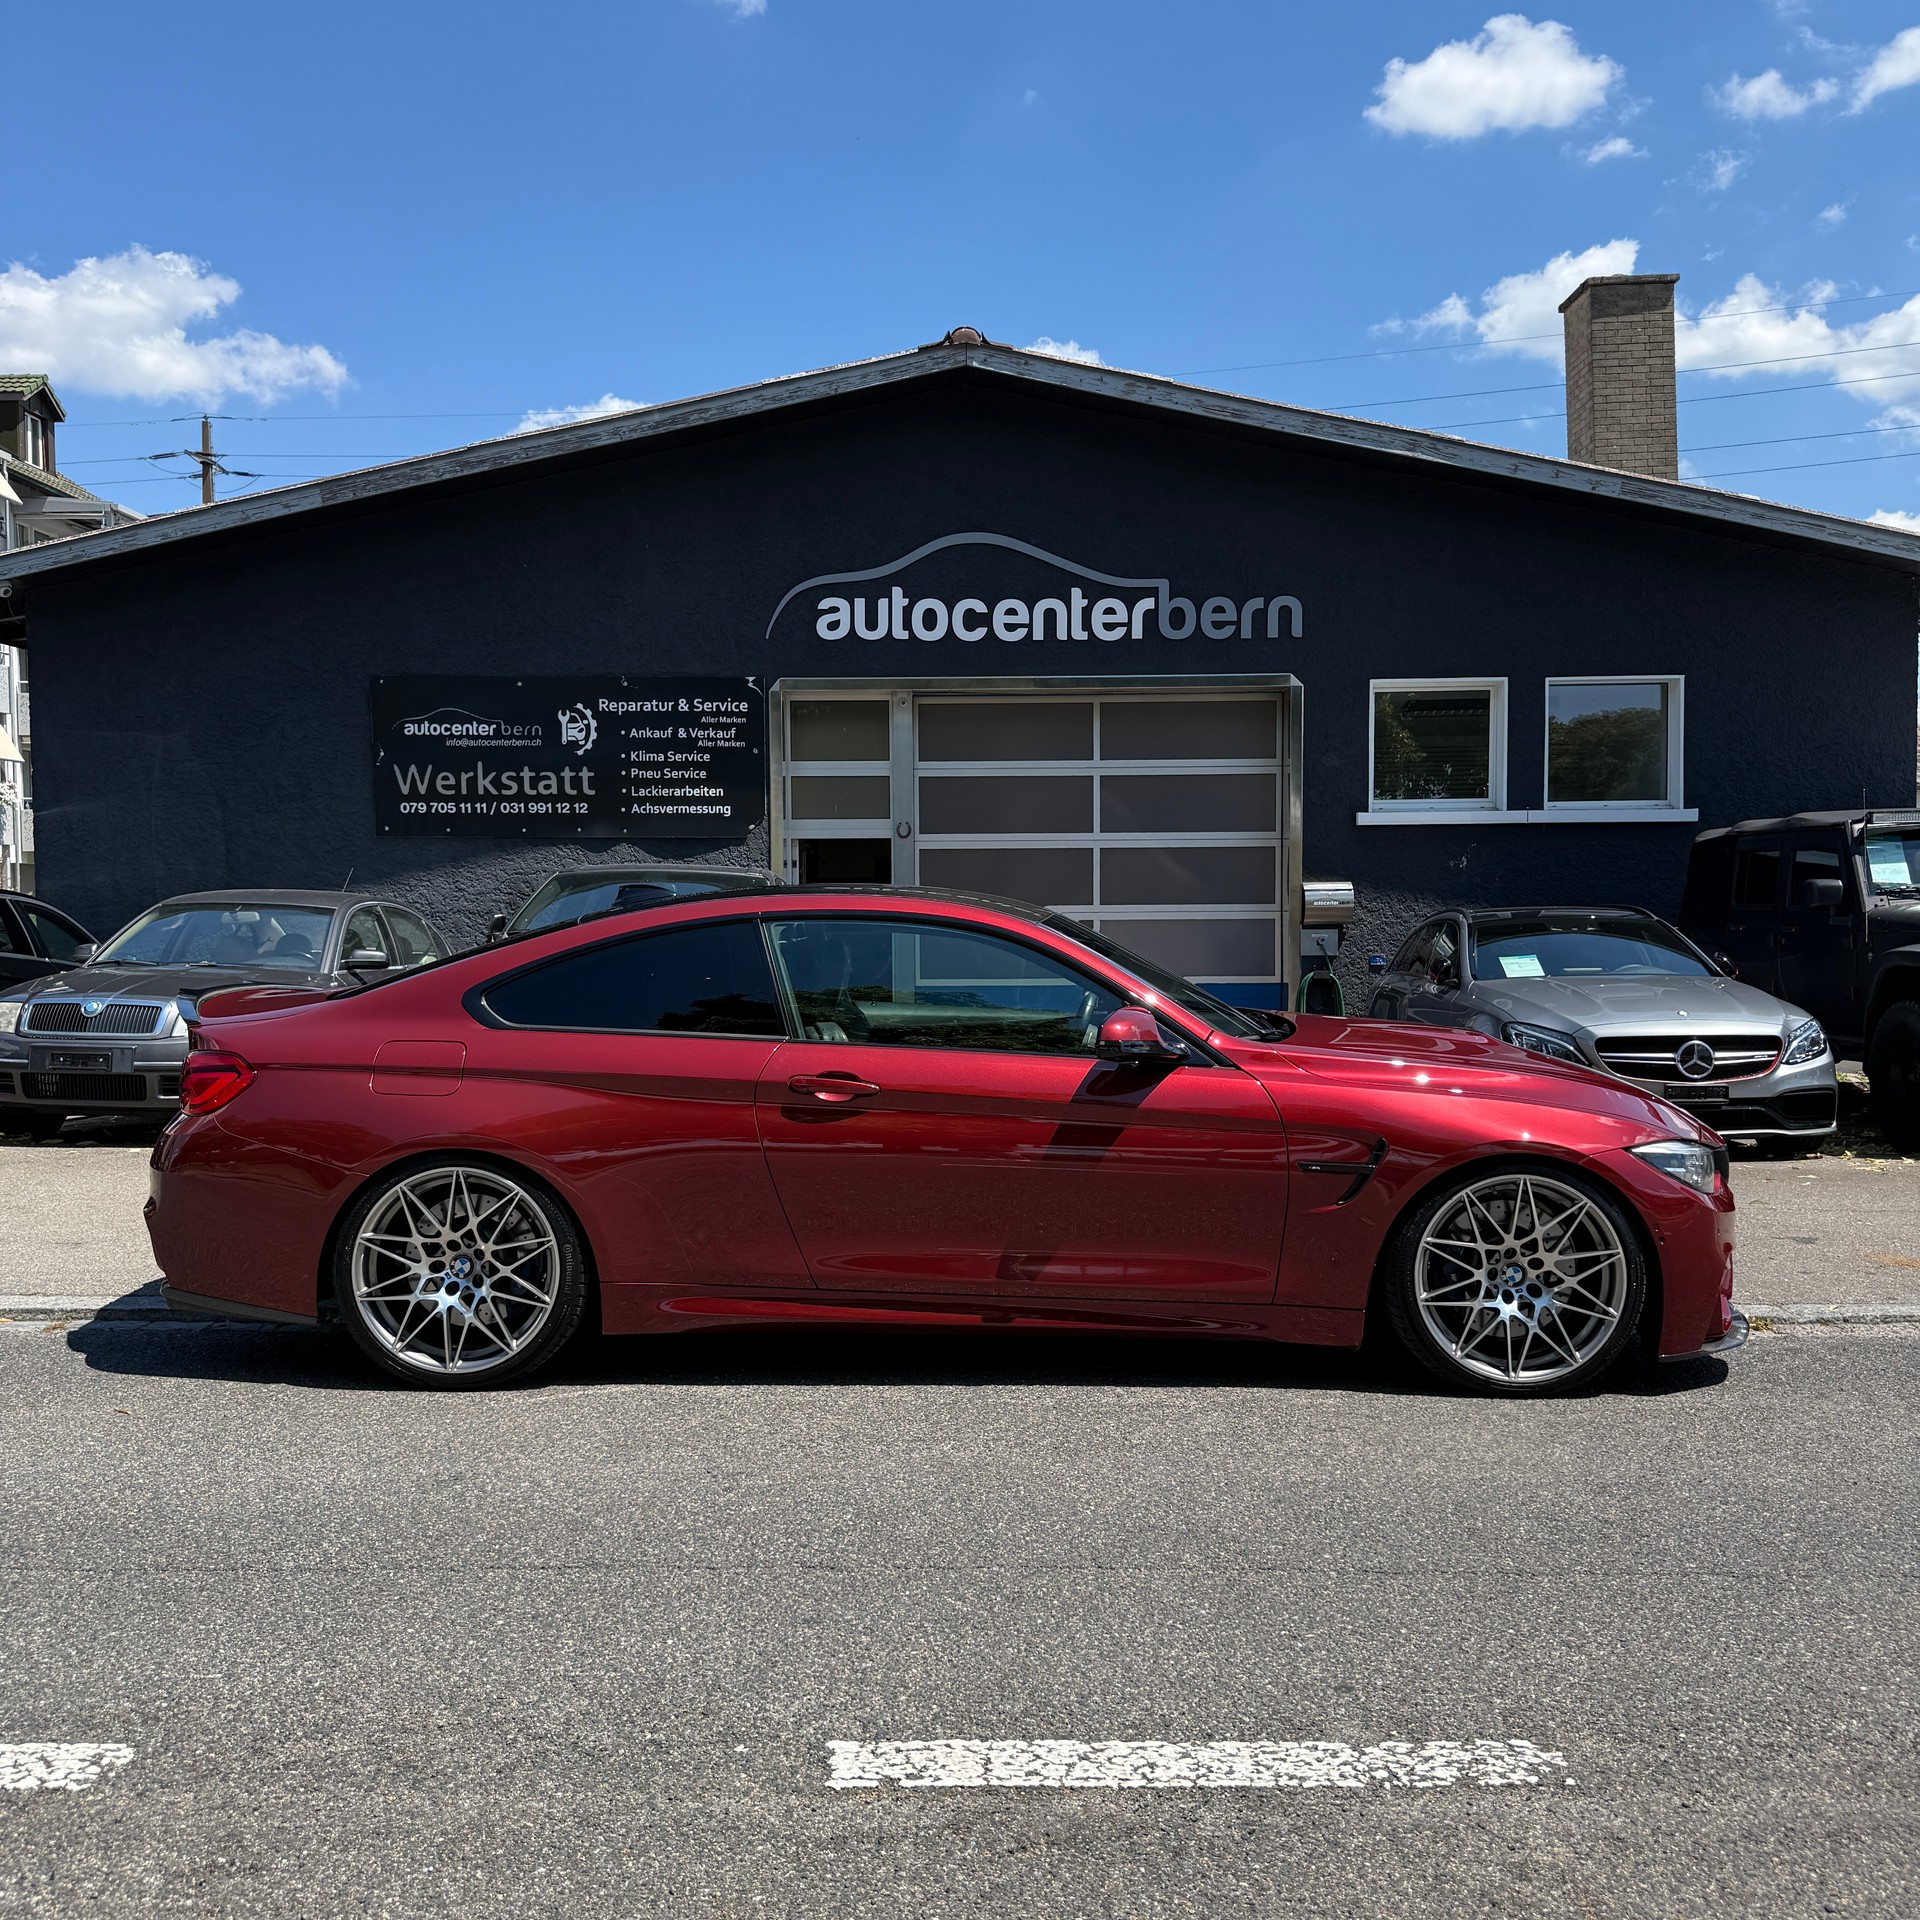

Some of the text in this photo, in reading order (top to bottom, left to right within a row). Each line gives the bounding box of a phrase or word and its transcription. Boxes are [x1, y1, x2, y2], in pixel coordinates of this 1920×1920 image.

[599, 698, 748, 715] Reparatur & Service
[404, 720, 542, 736] autocenter bern
[630, 727, 736, 738] Ankauf & Verkauf
[446, 738, 541, 747] info@autocenterbern.ch
[631, 751, 710, 761] Klima Service
[394, 761, 595, 795] Werkstatt
[631, 768, 706, 778] Pneu Service
[632, 785, 723, 796] Lackierarbeiten
[400, 803, 426, 813] 079
[430, 803, 456, 813] 705
[490, 802, 496, 815] /
[501, 803, 524, 813] 031
[528, 803, 551, 813] 991
[556, 803, 570, 813] 12
[574, 803, 588, 813] 12
[632, 803, 730, 816] Achsvermessung
